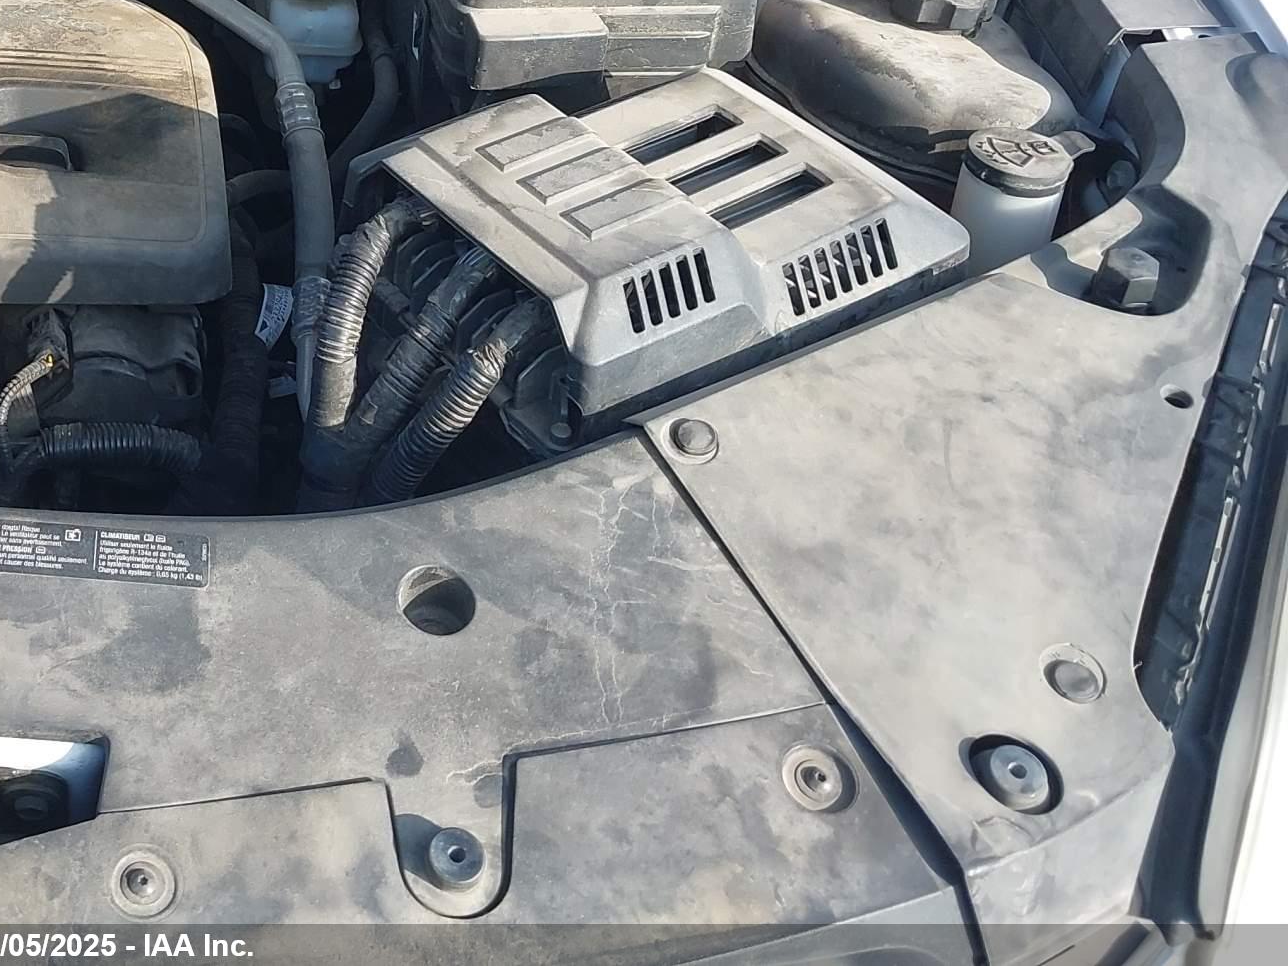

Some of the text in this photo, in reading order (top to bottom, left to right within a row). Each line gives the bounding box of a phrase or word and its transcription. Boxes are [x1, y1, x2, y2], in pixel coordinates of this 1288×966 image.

[100, 531, 140, 541] CLIMATISEUR
[120, 541, 150, 549] seulement
[2, 545, 33, 554] PRESSION
[130, 549, 152, 557] R-134a
[8, 553, 36, 561] personnel
